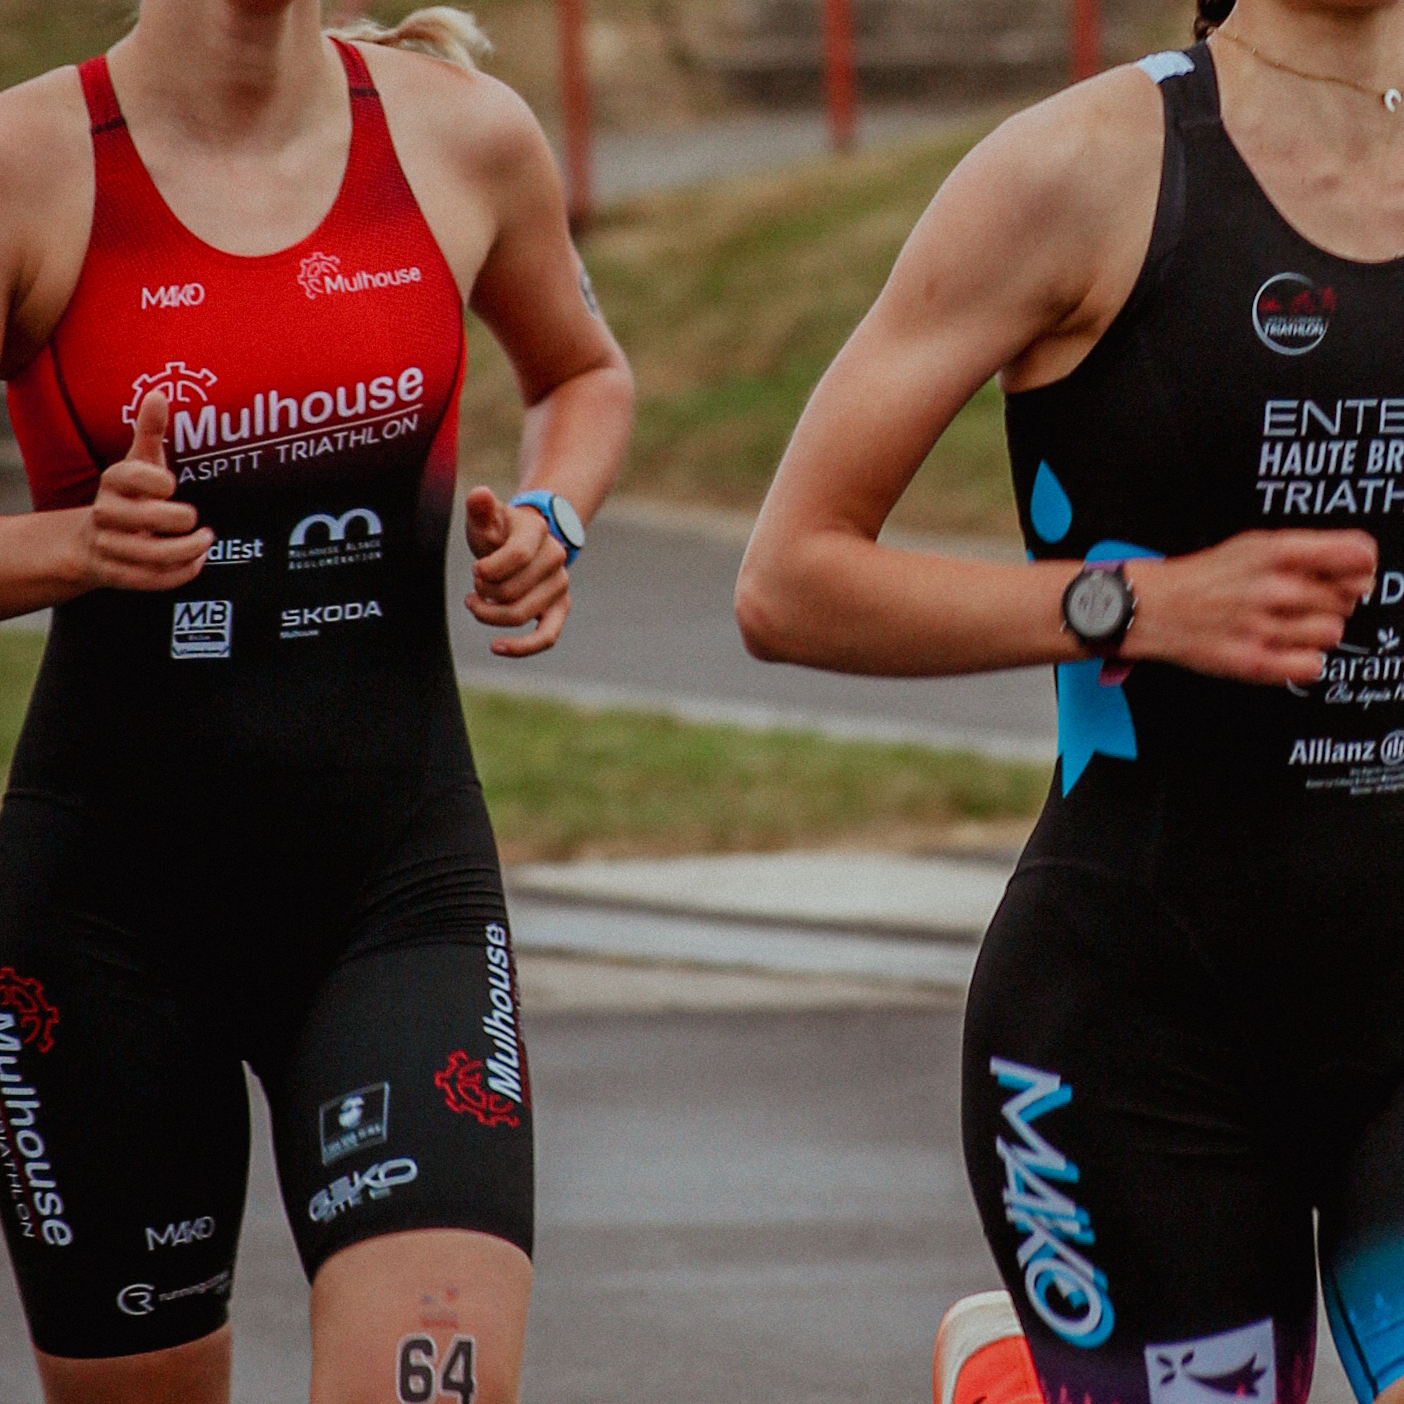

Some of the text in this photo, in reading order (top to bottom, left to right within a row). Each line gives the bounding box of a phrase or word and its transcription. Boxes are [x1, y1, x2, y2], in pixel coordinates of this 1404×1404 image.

[323, 265, 422, 295] Mulhouse
[174, 365, 424, 454] Mulhouse
[178, 414, 420, 484] ASPTT TRIATHLON
[1258, 439, 1358, 476] HAUTE
[1288, 738, 1377, 765] Allianz
[483, 921, 522, 1104] Mulhouse
